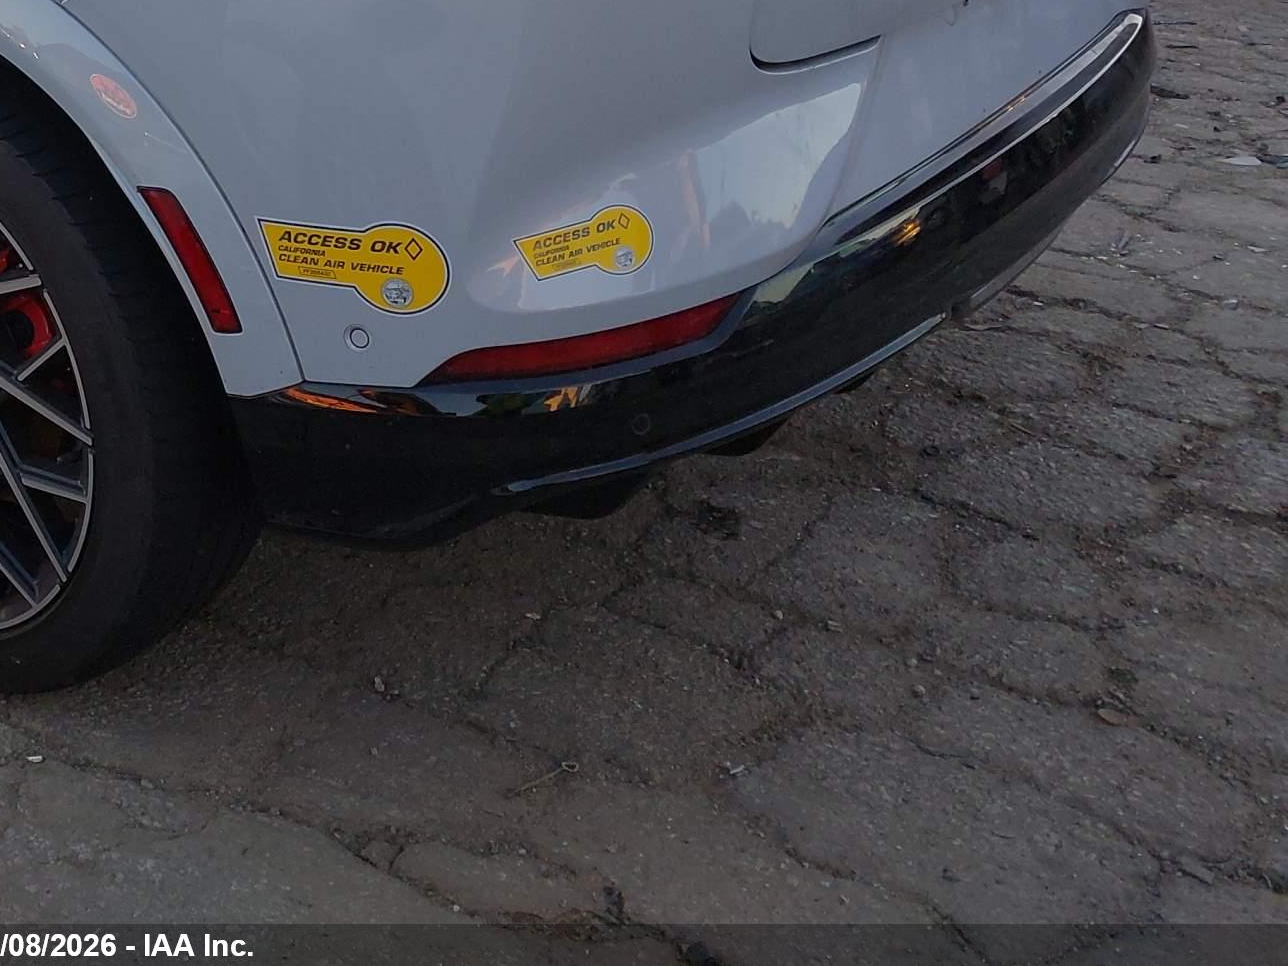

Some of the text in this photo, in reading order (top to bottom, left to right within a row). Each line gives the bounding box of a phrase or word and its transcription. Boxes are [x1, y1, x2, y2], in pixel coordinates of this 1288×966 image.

[279, 231, 403, 254] ACCESS OK
[533, 219, 616, 251] ACCESS OK
[278, 245, 326, 257] CALIFORNIA
[536, 253, 565, 266] CLEAN
[568, 248, 583, 259] AIR
[586, 238, 621, 253] VEHICLE
[278, 254, 405, 275] CLEAN AIR VEHICLE
